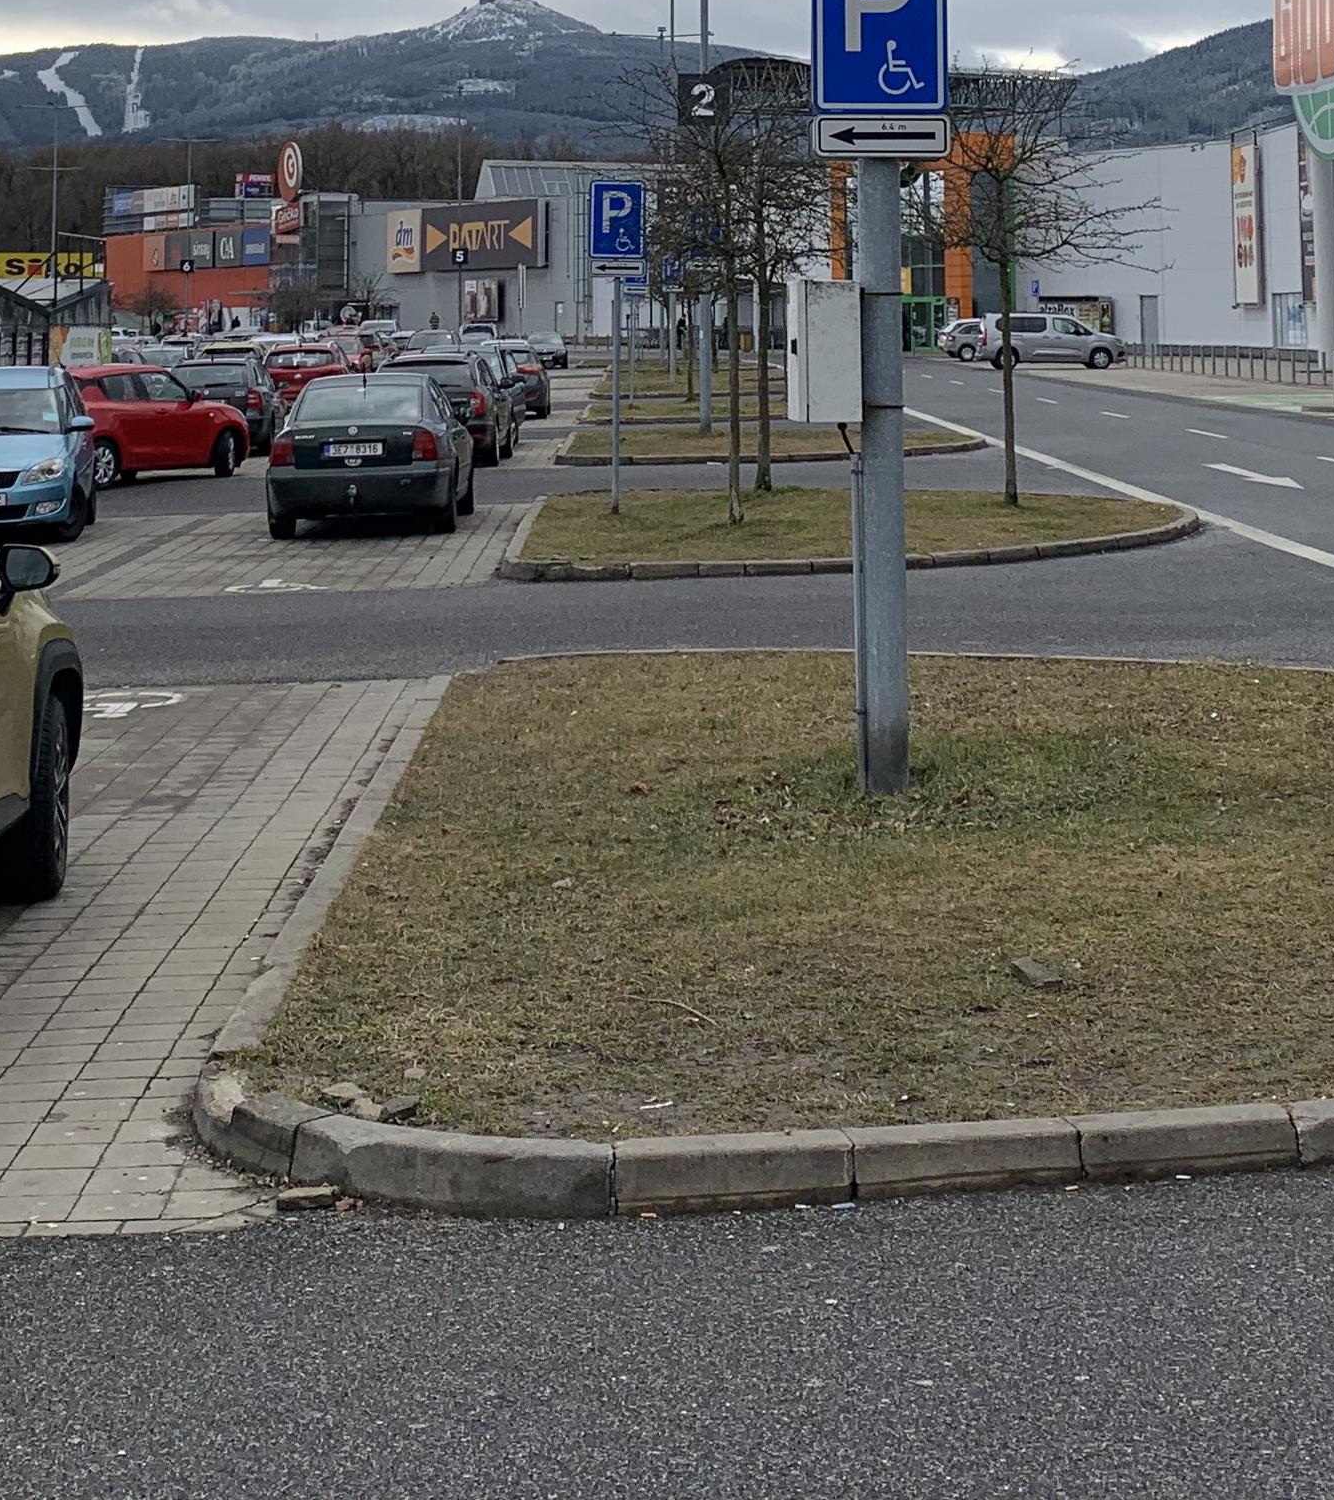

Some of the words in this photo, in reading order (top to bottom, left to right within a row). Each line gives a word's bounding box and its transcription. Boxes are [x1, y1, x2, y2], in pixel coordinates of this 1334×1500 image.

[690, 83, 716, 117] 2
[882, 122, 895, 131] 6.4
[602, 190, 633, 234] P
[395, 221, 414, 247] dm
[455, 251, 464, 262] 5
[183, 262, 190, 271] 6
